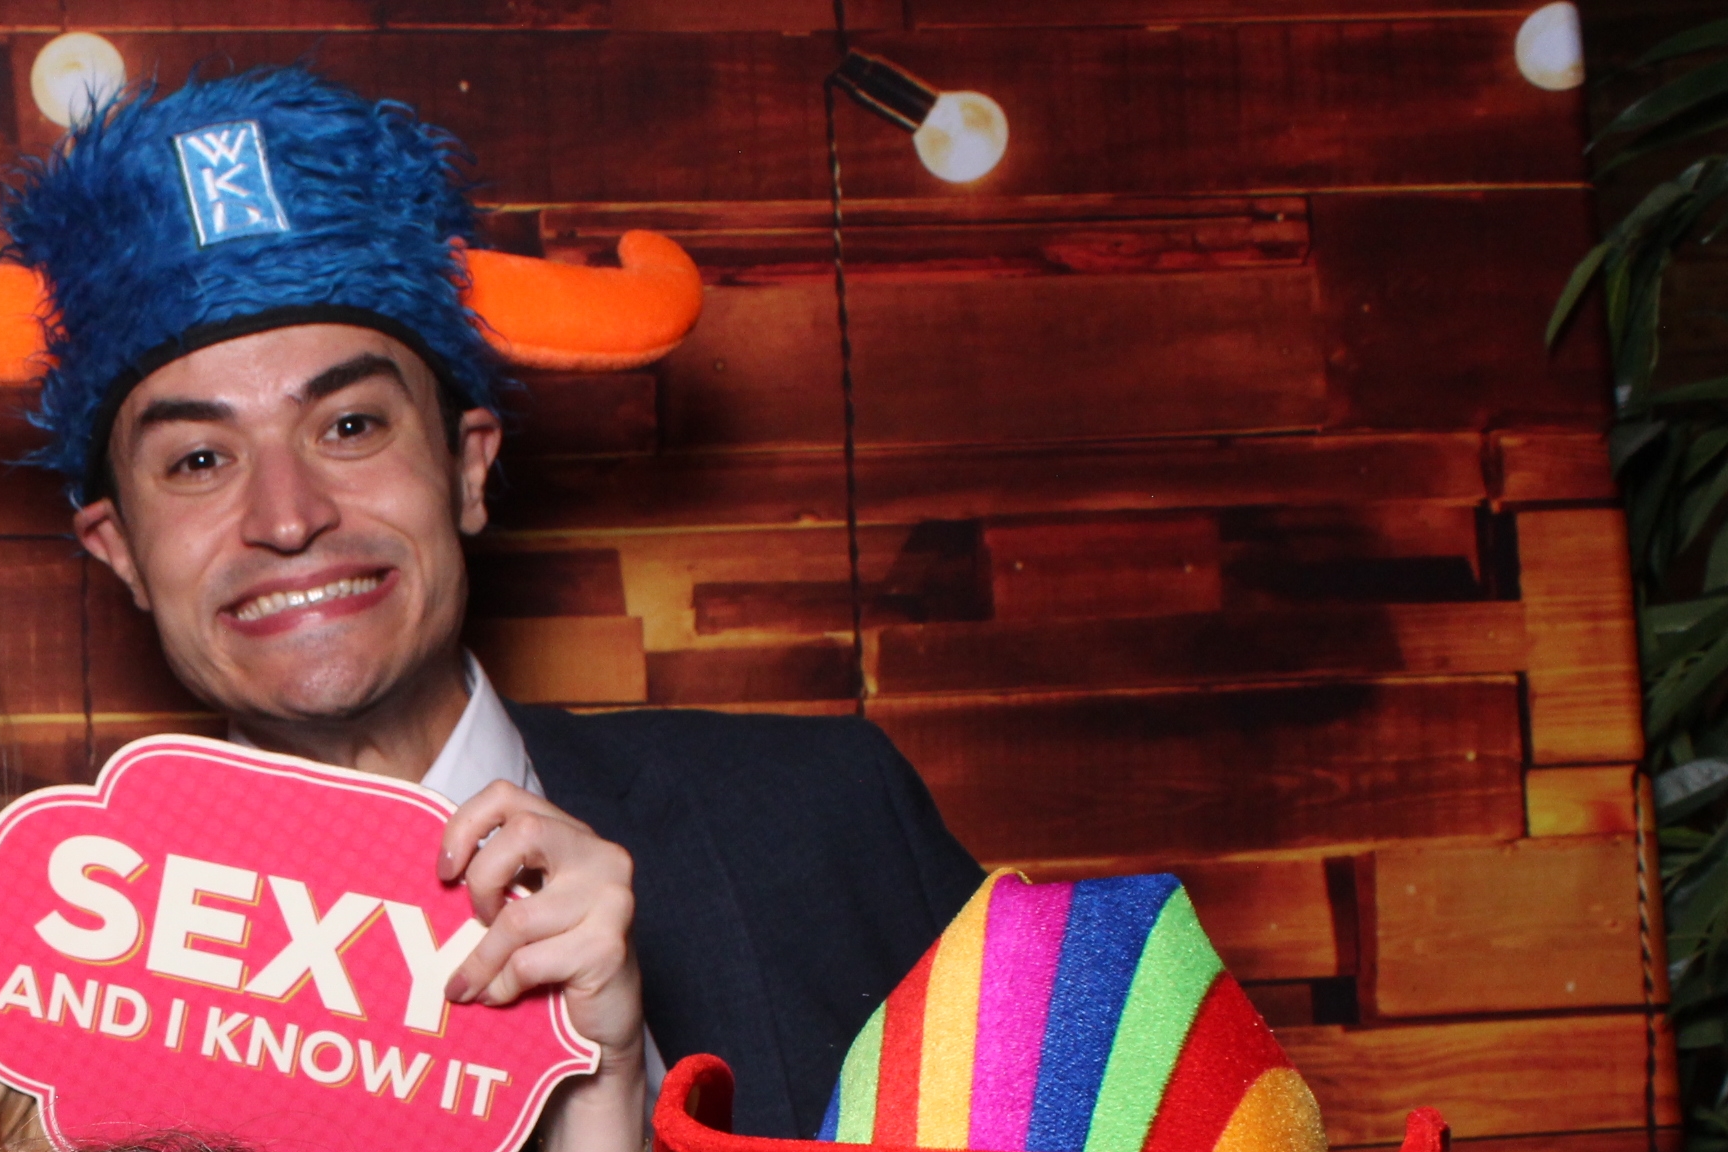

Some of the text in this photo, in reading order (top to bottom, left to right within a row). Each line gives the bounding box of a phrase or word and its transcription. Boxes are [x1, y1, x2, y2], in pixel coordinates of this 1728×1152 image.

[34, 834, 490, 1037] SEXY
[164, 998, 189, 1050] I
[202, 1007, 435, 1104] KNOW
[439, 1059, 511, 1120] IT
